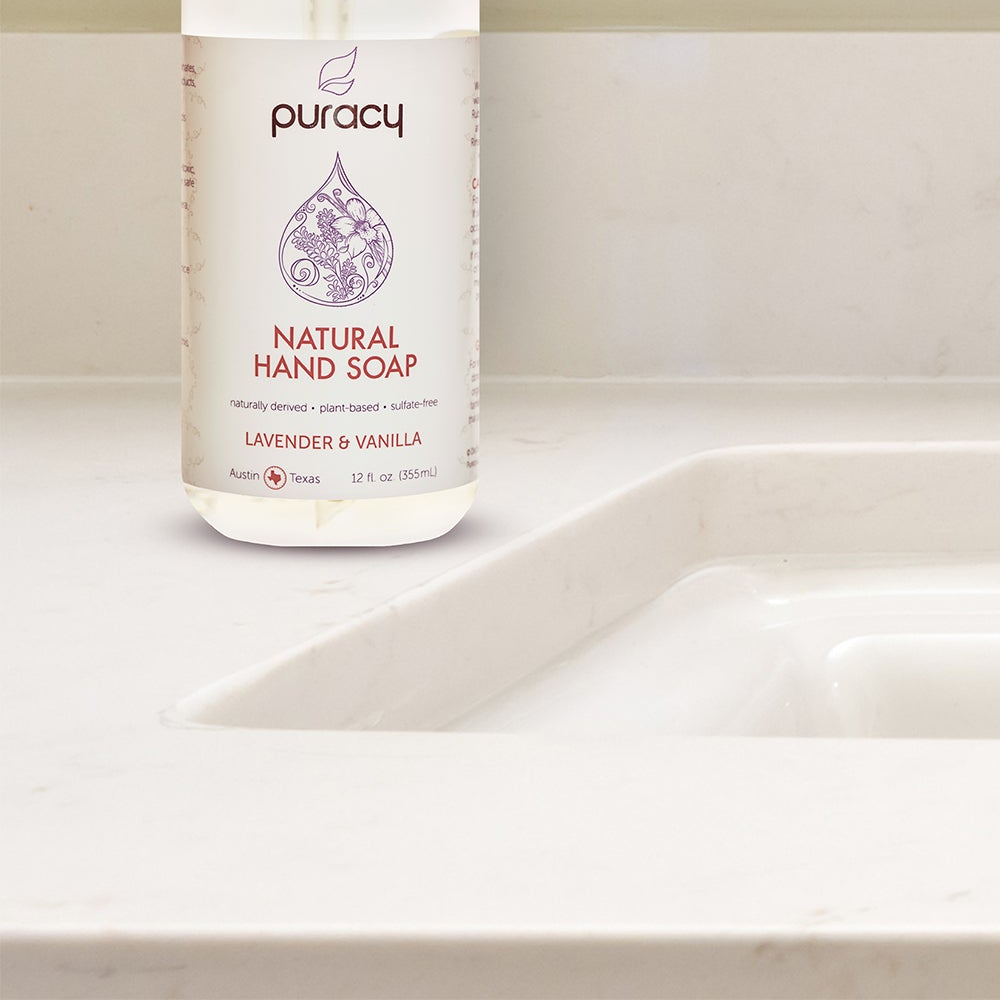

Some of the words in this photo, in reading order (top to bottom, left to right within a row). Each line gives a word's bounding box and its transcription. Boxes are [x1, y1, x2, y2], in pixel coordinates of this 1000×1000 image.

[271, 103, 403, 138] puracy
[273, 324, 400, 350] NATURAL
[254, 354, 336, 380] HAND
[346, 354, 418, 379] SOAP
[230, 398, 269, 412] naturally
[270, 400, 307, 412] derived
[319, 402, 380, 414] plant-based
[390, 397, 438, 411] sulfate-free
[245, 431, 333, 450] LAVENDER
[338, 436, 350, 450] &
[355, 431, 422, 449] VANILLA
[229, 468, 260, 480] Austin
[289, 473, 321, 484] Texas
[351, 472, 364, 484] 12
[398, 466, 438, 482] (355mL)
